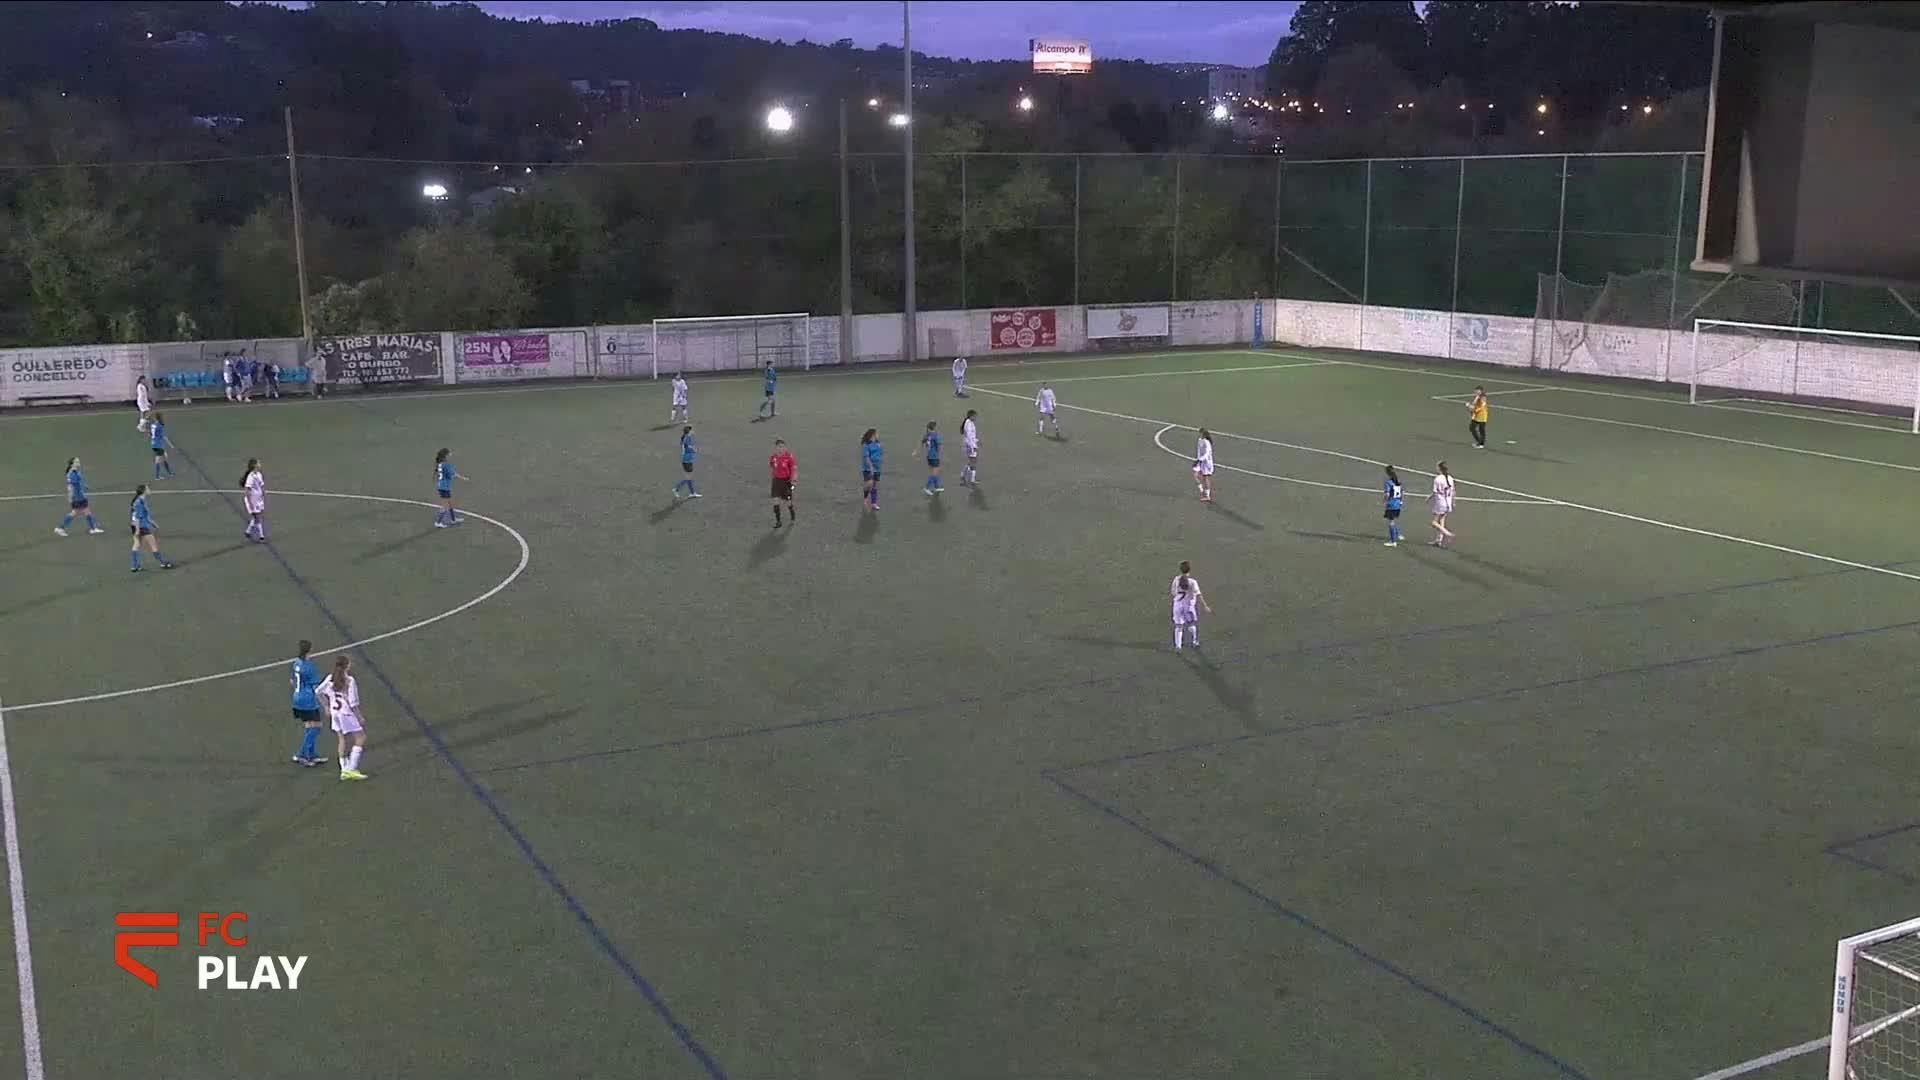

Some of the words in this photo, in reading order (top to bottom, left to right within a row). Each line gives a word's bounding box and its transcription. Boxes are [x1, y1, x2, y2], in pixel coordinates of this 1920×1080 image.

[1036, 42, 1076, 54] Alcampo
[336, 336, 371, 351] TRES
[376, 335, 433, 352] MARIAS
[464, 342, 491, 354] 25N
[13, 371, 87, 382] CONCELLO
[1178, 591, 1186, 602] 7
[333, 694, 343, 711] 5
